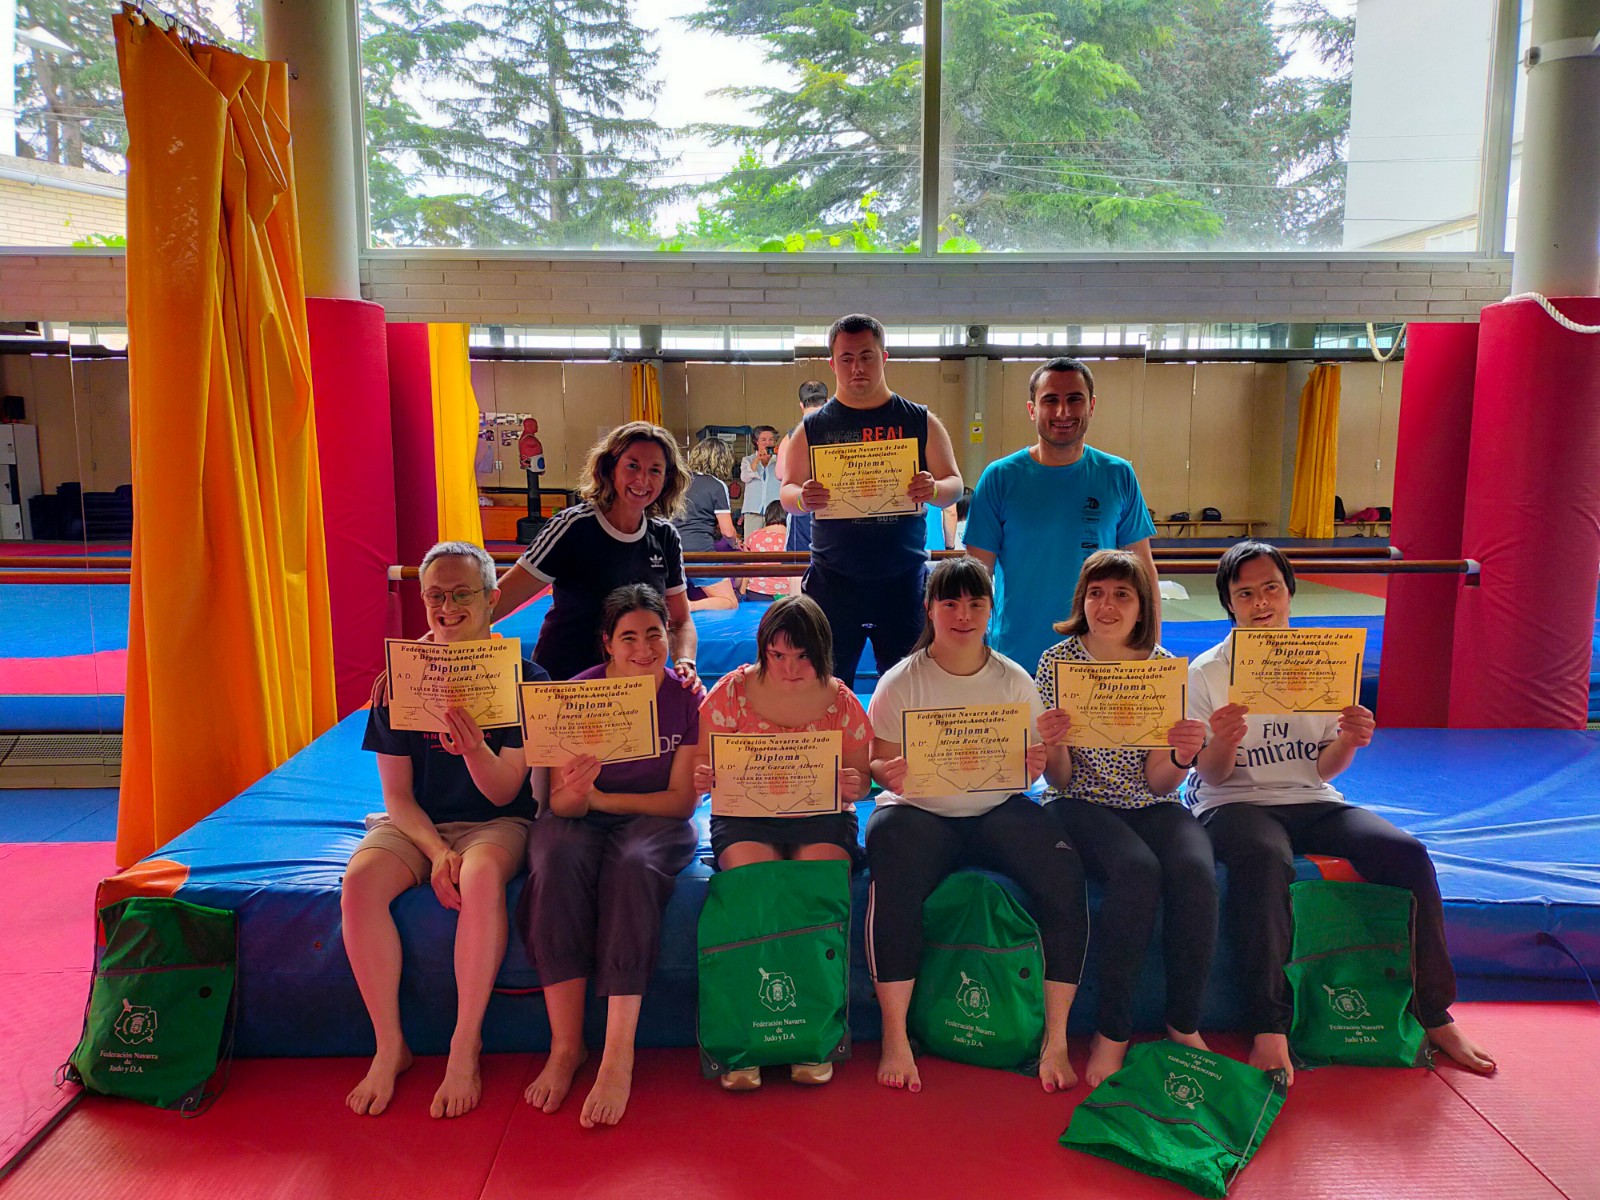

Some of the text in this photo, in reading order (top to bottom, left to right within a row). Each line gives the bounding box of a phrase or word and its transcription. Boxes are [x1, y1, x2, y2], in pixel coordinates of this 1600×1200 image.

[848, 461, 884, 469] Diploma
[1274, 649, 1320, 657] Diploma
[430, 663, 477, 674] Diploma
[1099, 682, 1146, 692] Diploma
[566, 701, 613, 711] Diploma
[945, 727, 989, 737] Diploma
[1263, 722, 1288, 738] Fly
[754, 754, 800, 762] Diploma
[1235, 739, 1318, 767] Emirate
[100, 1050, 133, 1058] Federación
